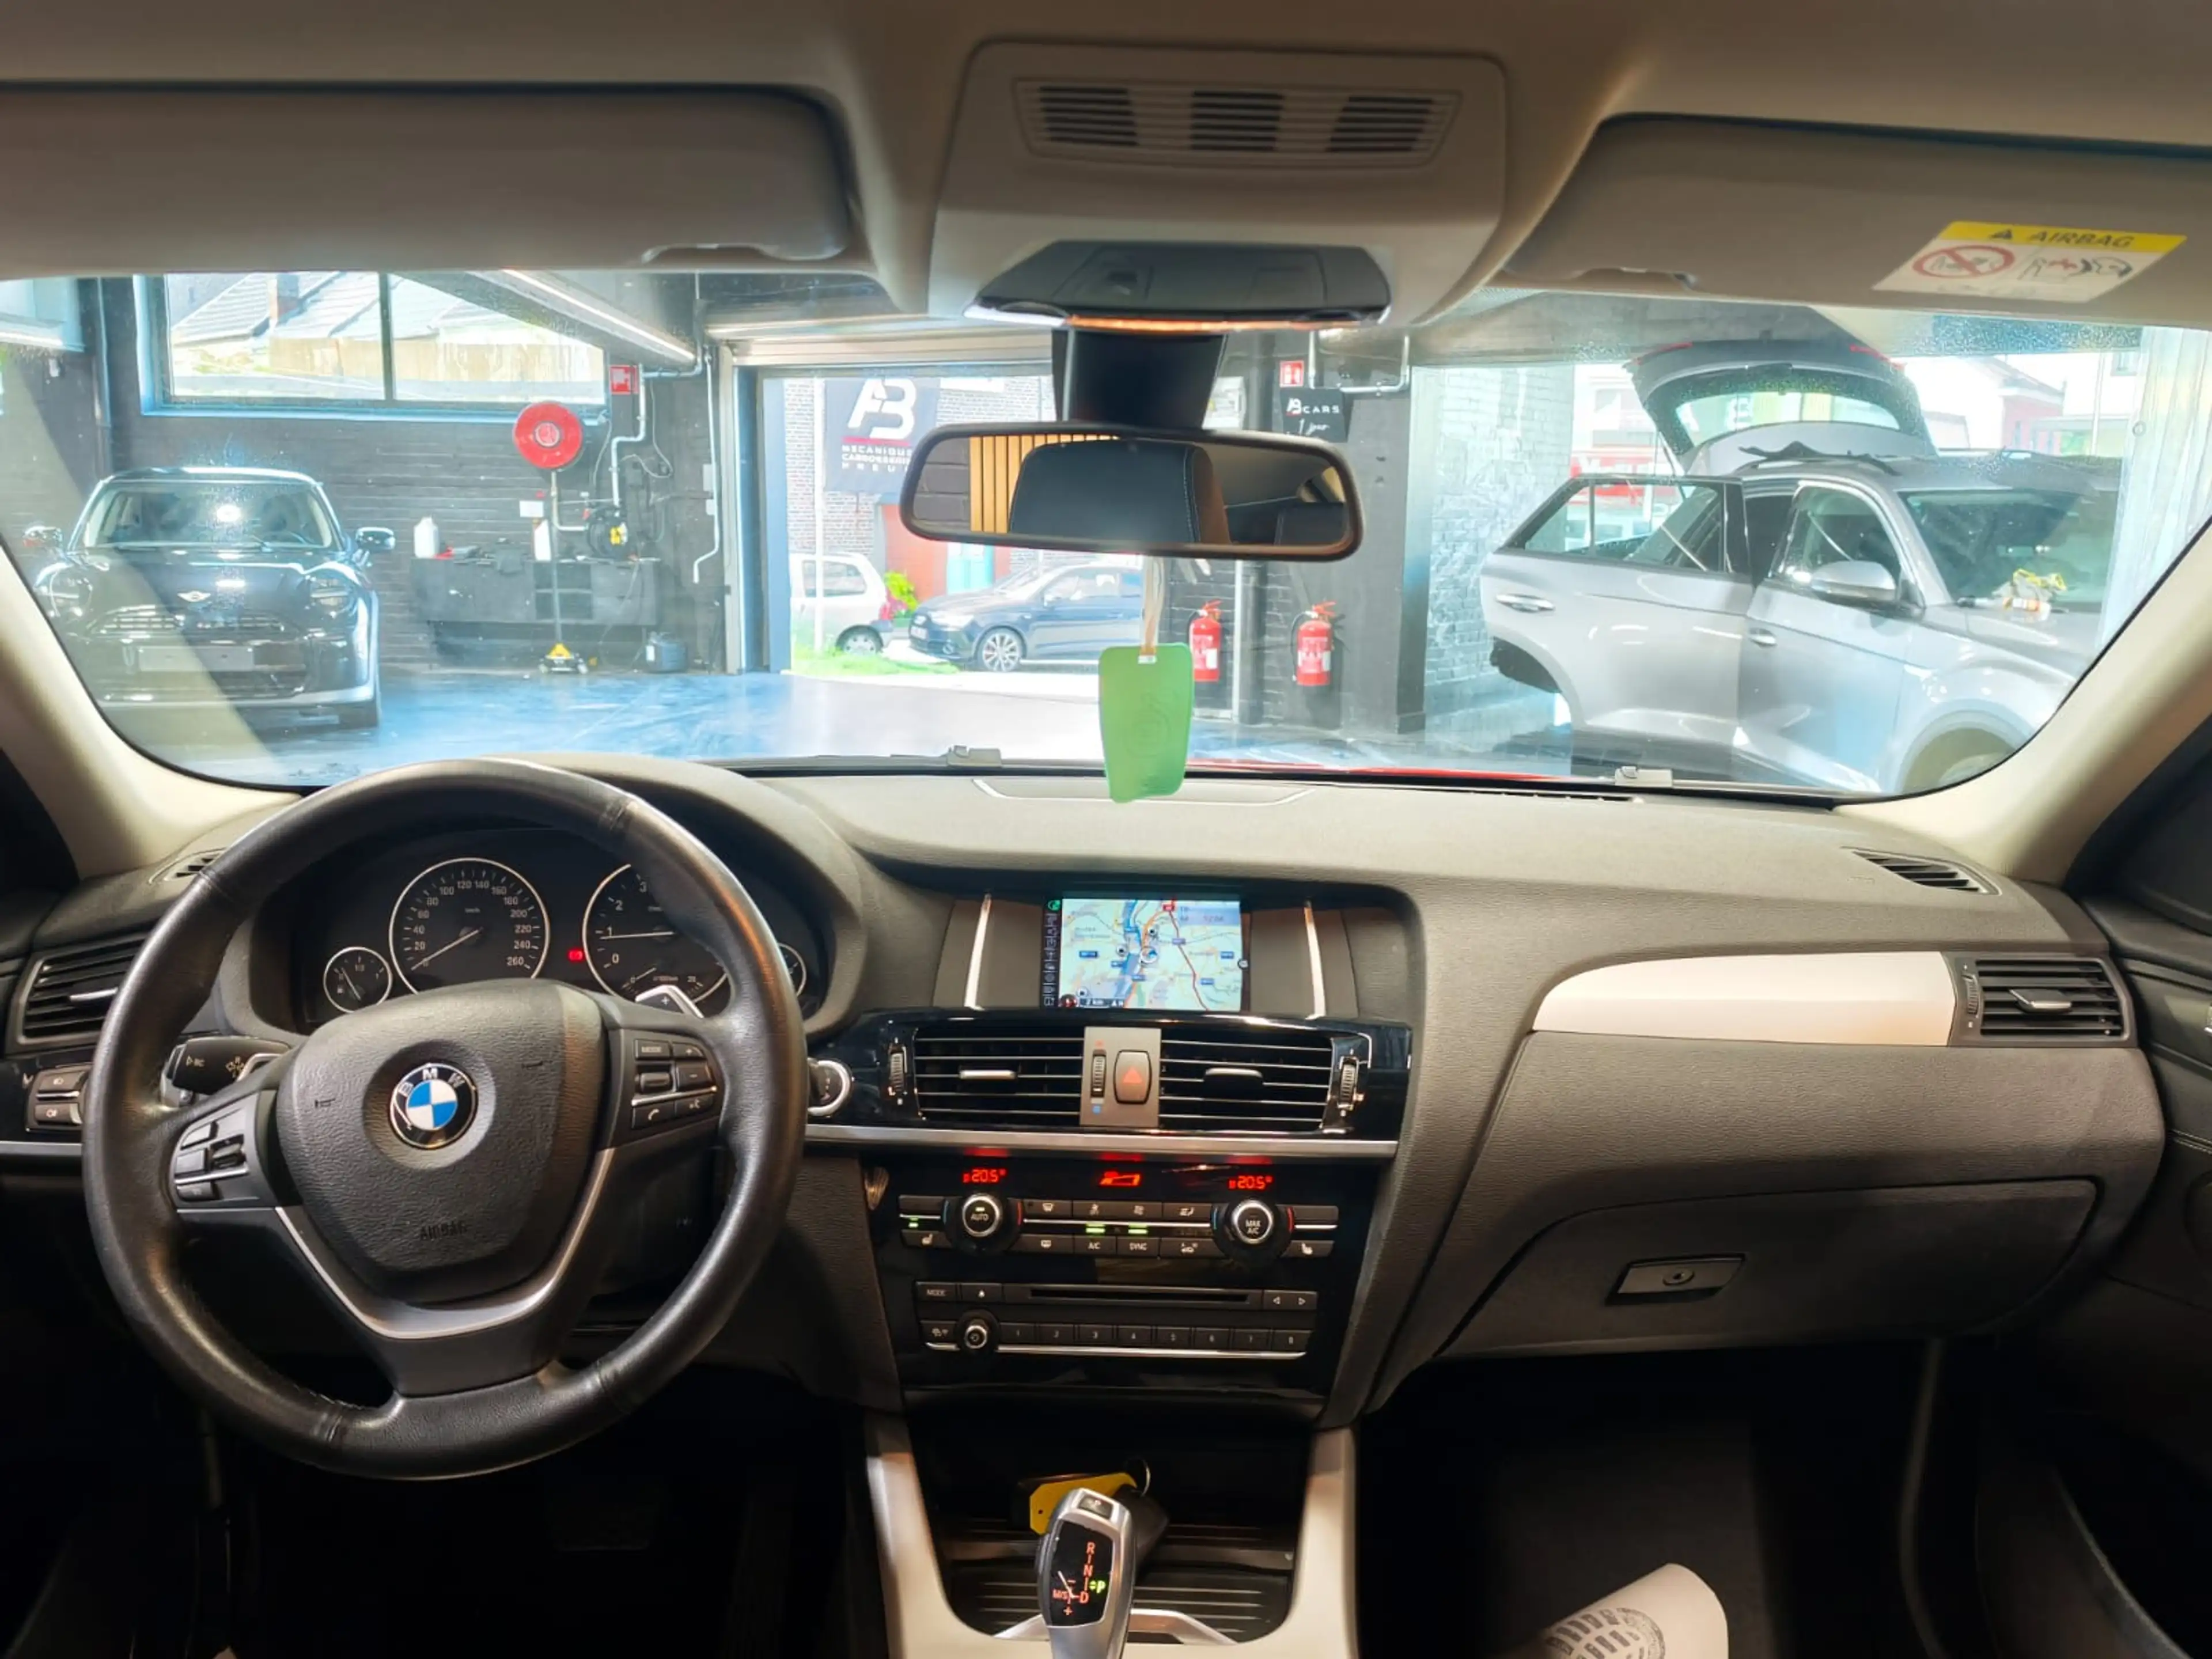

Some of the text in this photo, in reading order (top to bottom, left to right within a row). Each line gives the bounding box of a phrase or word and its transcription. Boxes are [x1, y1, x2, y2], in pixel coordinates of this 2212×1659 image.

[2027, 230, 2135, 248] AIRBAG
[1303, 405, 1339, 414] CARS
[457, 880, 490, 889] 120 140
[639, 882, 647, 893] 3
[439, 887, 454, 895] 100
[427, 897, 439, 906] 80
[615, 900, 623, 911] 2
[418, 910, 430, 919] 60
[510, 910, 528, 918] 200
[413, 925, 532, 934] 40 220
[607, 927, 613, 937] 1
[414, 941, 531, 950] 20 240
[507, 957, 524, 966] 260
[612, 954, 620, 964] 0
[397, 1067, 465, 1097] BMW
[1245, 1219, 1261, 1228] MAX
[1088, 1242, 1101, 1250] A/C
[1129, 1242, 1147, 1251] SYNC
[1086, 1541, 1096, 1555] R
[1084, 1565, 1093, 1577] N
[1096, 1580, 1106, 1594] P
[1080, 1591, 1090, 1604] D
